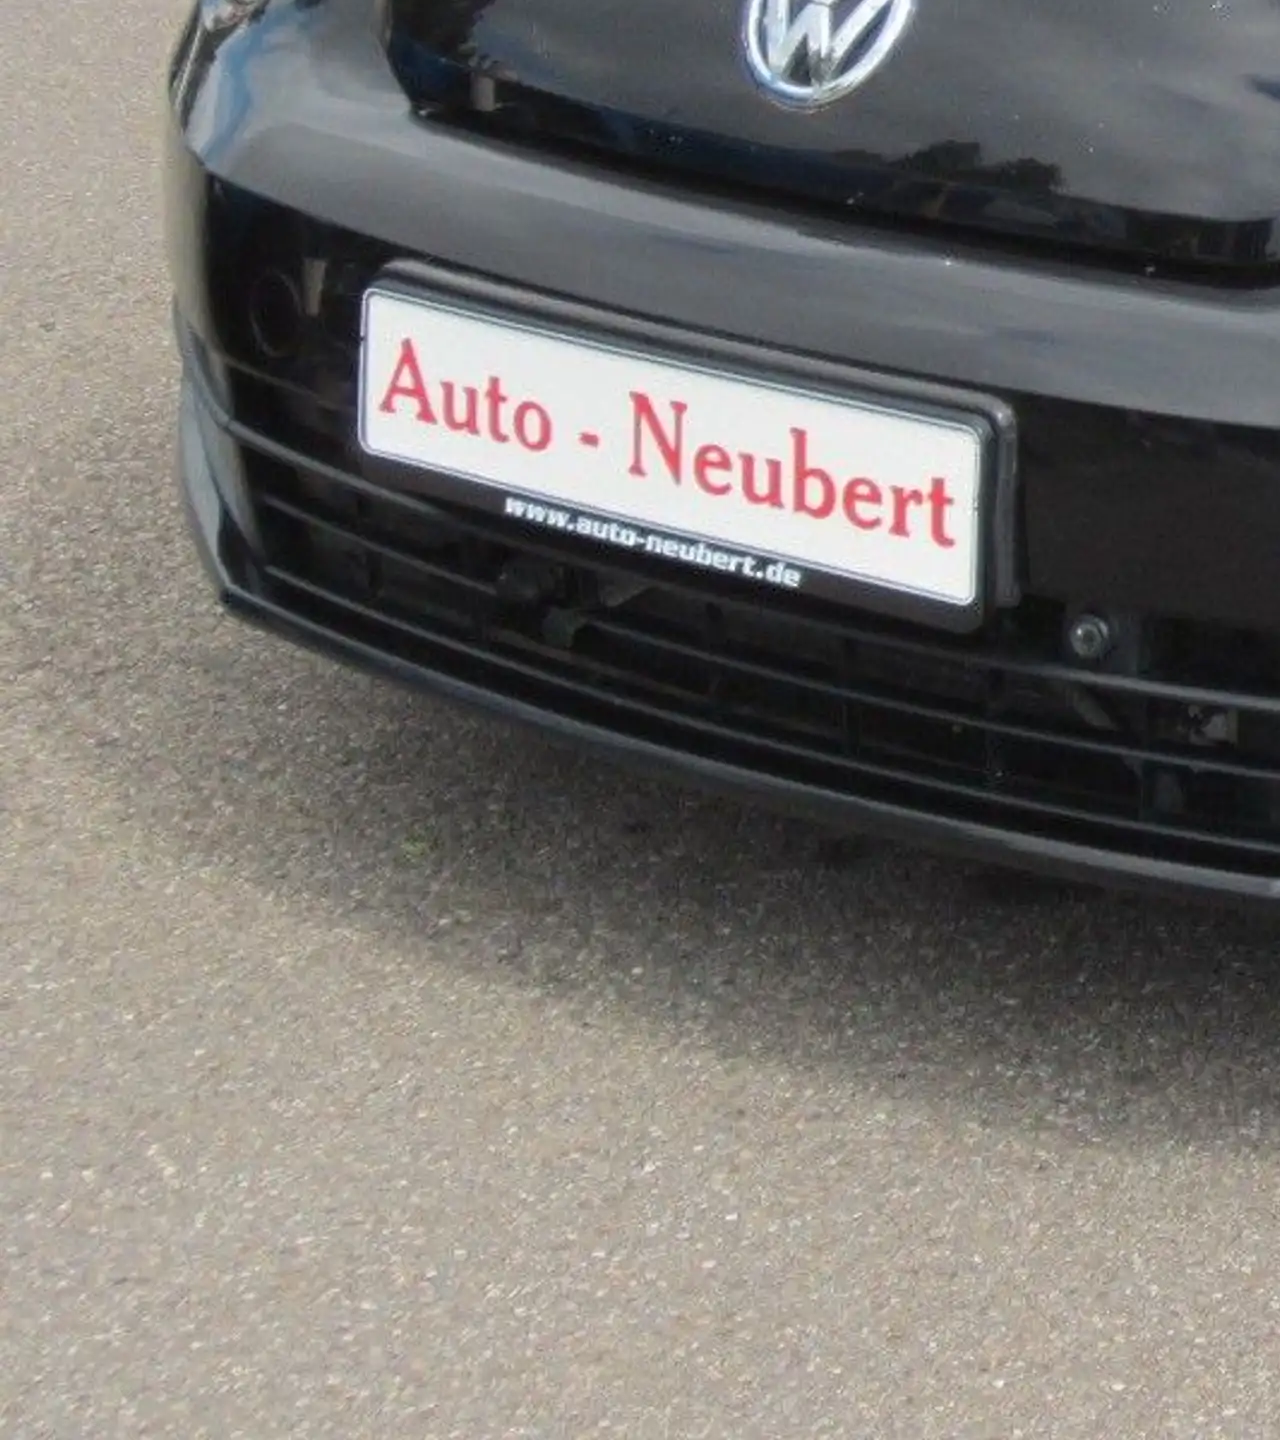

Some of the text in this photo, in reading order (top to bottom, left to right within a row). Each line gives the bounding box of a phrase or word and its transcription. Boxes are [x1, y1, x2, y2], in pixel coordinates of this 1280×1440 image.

[379, 337, 552, 452] Auto
[629, 391, 955, 548] Neubert
[505, 497, 801, 588] www.auto-neubert.de
